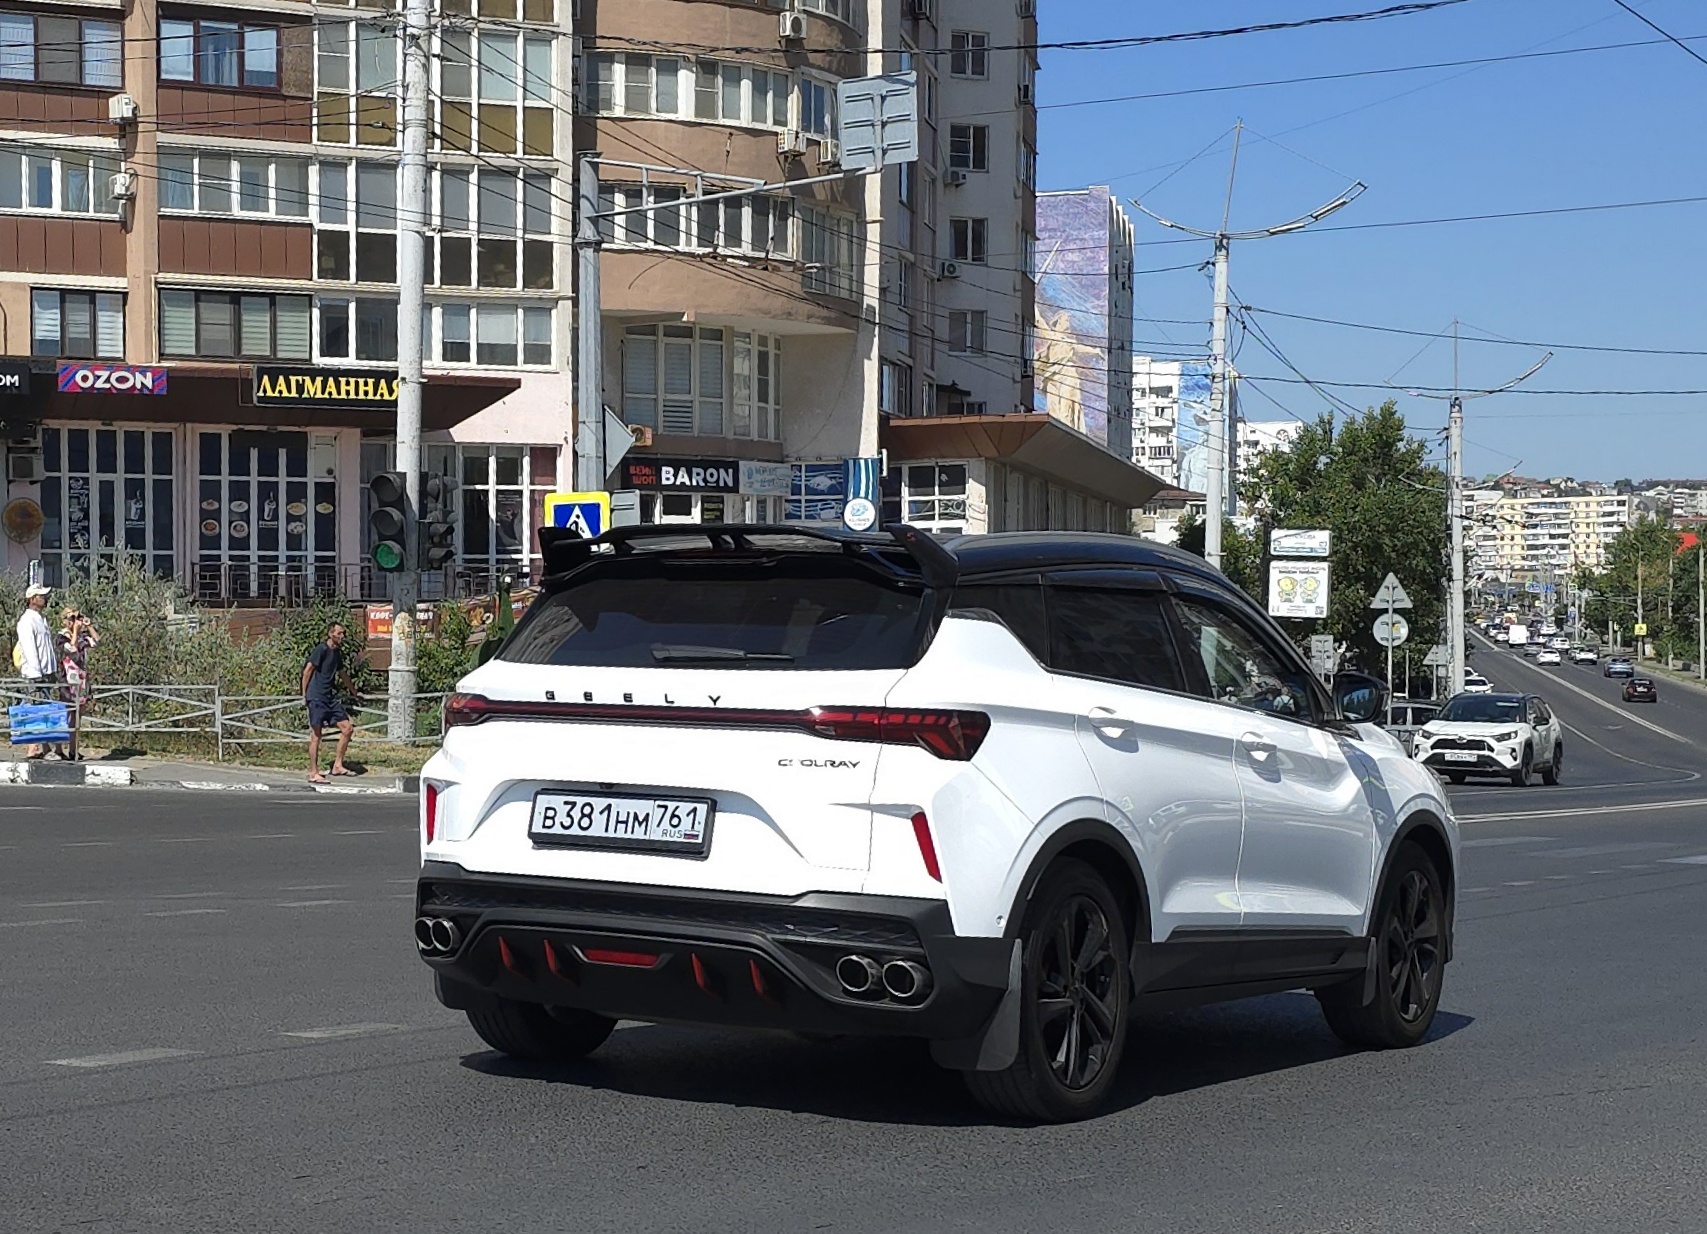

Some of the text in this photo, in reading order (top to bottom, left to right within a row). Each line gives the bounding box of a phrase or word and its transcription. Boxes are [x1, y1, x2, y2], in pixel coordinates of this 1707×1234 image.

[75, 369, 153, 390] OZON
[256, 374, 398, 401] ЛАГМАННАЯ
[632, 475, 657, 485] ШОП
[661, 466, 734, 487] BARON
[545, 690, 721, 706] GEELY
[656, 804, 699, 831] 761
[661, 828, 683, 839] RUS
